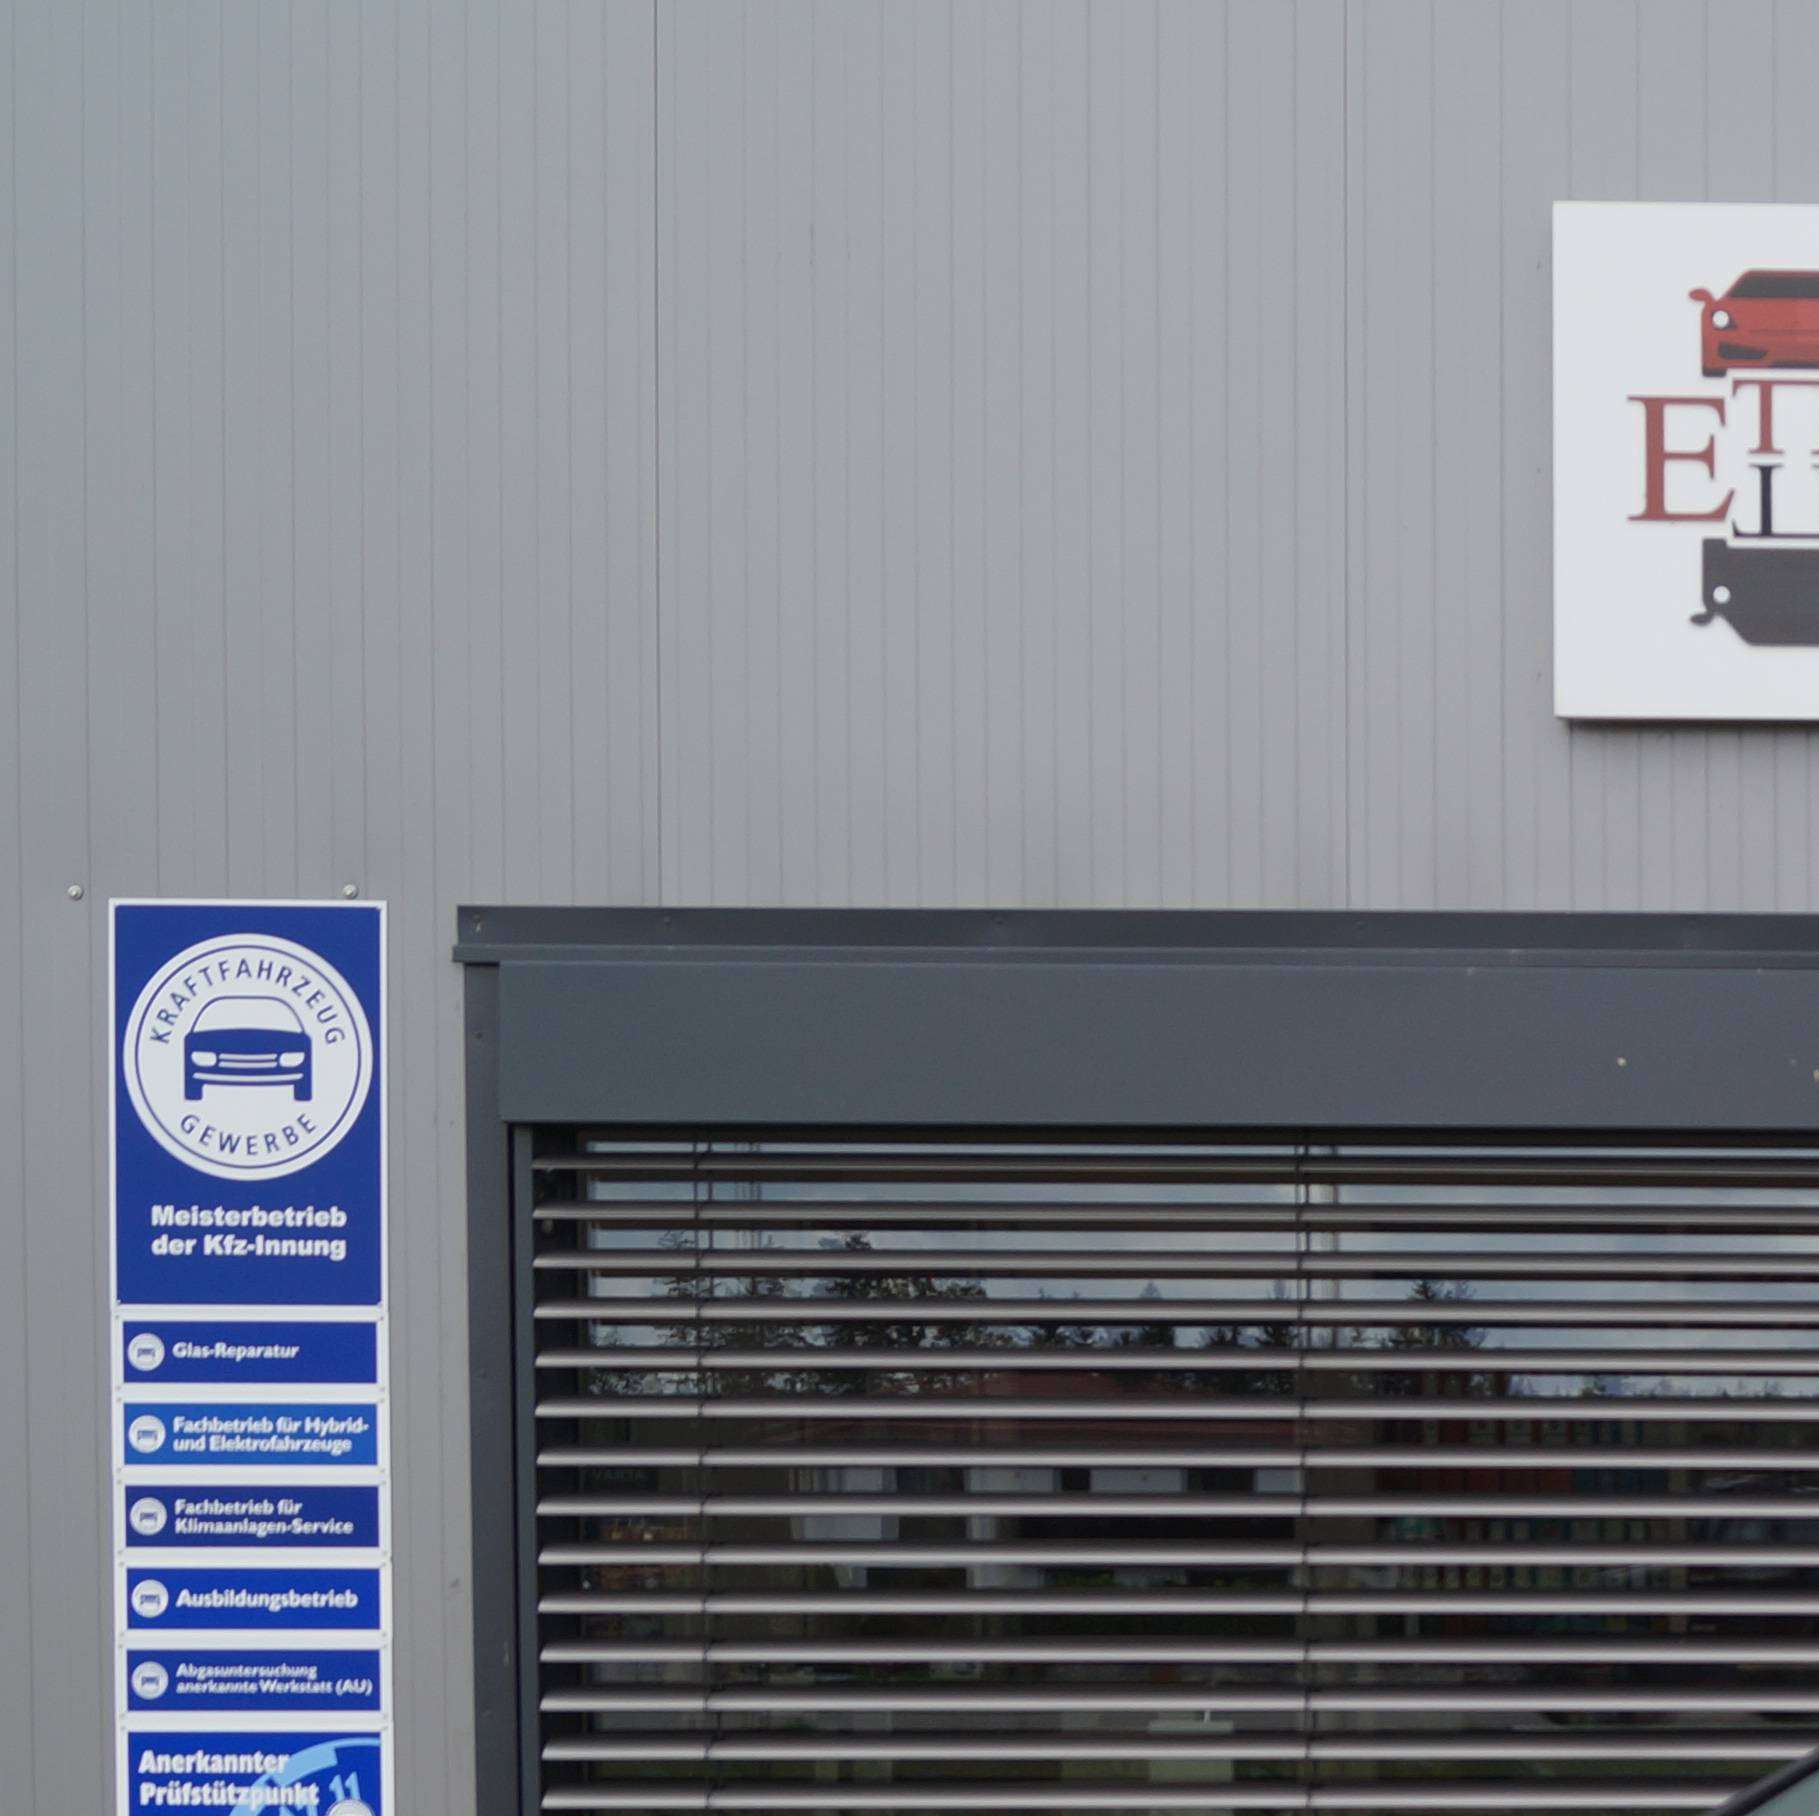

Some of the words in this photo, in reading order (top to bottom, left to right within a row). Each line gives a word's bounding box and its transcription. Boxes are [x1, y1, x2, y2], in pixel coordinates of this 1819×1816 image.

[150, 957, 346, 1046] KRAFTFAHRZEUG
[179, 1112, 317, 1157] GEWERBE
[150, 1204, 348, 1228] Meisterbetrieb
[150, 1234, 198, 1257] der
[203, 1234, 347, 1262] Kfz-Innung
[171, 1341, 300, 1363] Glas-Reparatur
[172, 1415, 274, 1434] Fachbetrieb
[275, 1415, 303, 1434] für
[304, 1416, 370, 1438] Hybrid-
[172, 1435, 207, 1453] und
[208, 1434, 353, 1457] Elektrofahrzeuge
[173, 1498, 275, 1516] Fachbetrieb
[276, 1498, 304, 1516] für
[174, 1516, 355, 1539] Klimaanlagen-Service
[174, 1588, 360, 1613] Ausbildungsbetrieb
[174, 1661, 318, 1680] Abgasuntersuchung
[174, 1678, 258, 1694] anerkannte
[259, 1678, 333, 1695] Werkstatt
[335, 1678, 374, 1696] (AU)
[137, 1749, 291, 1774] Anerkannter
[139, 1779, 320, 1812] Prüfstützpunkt
